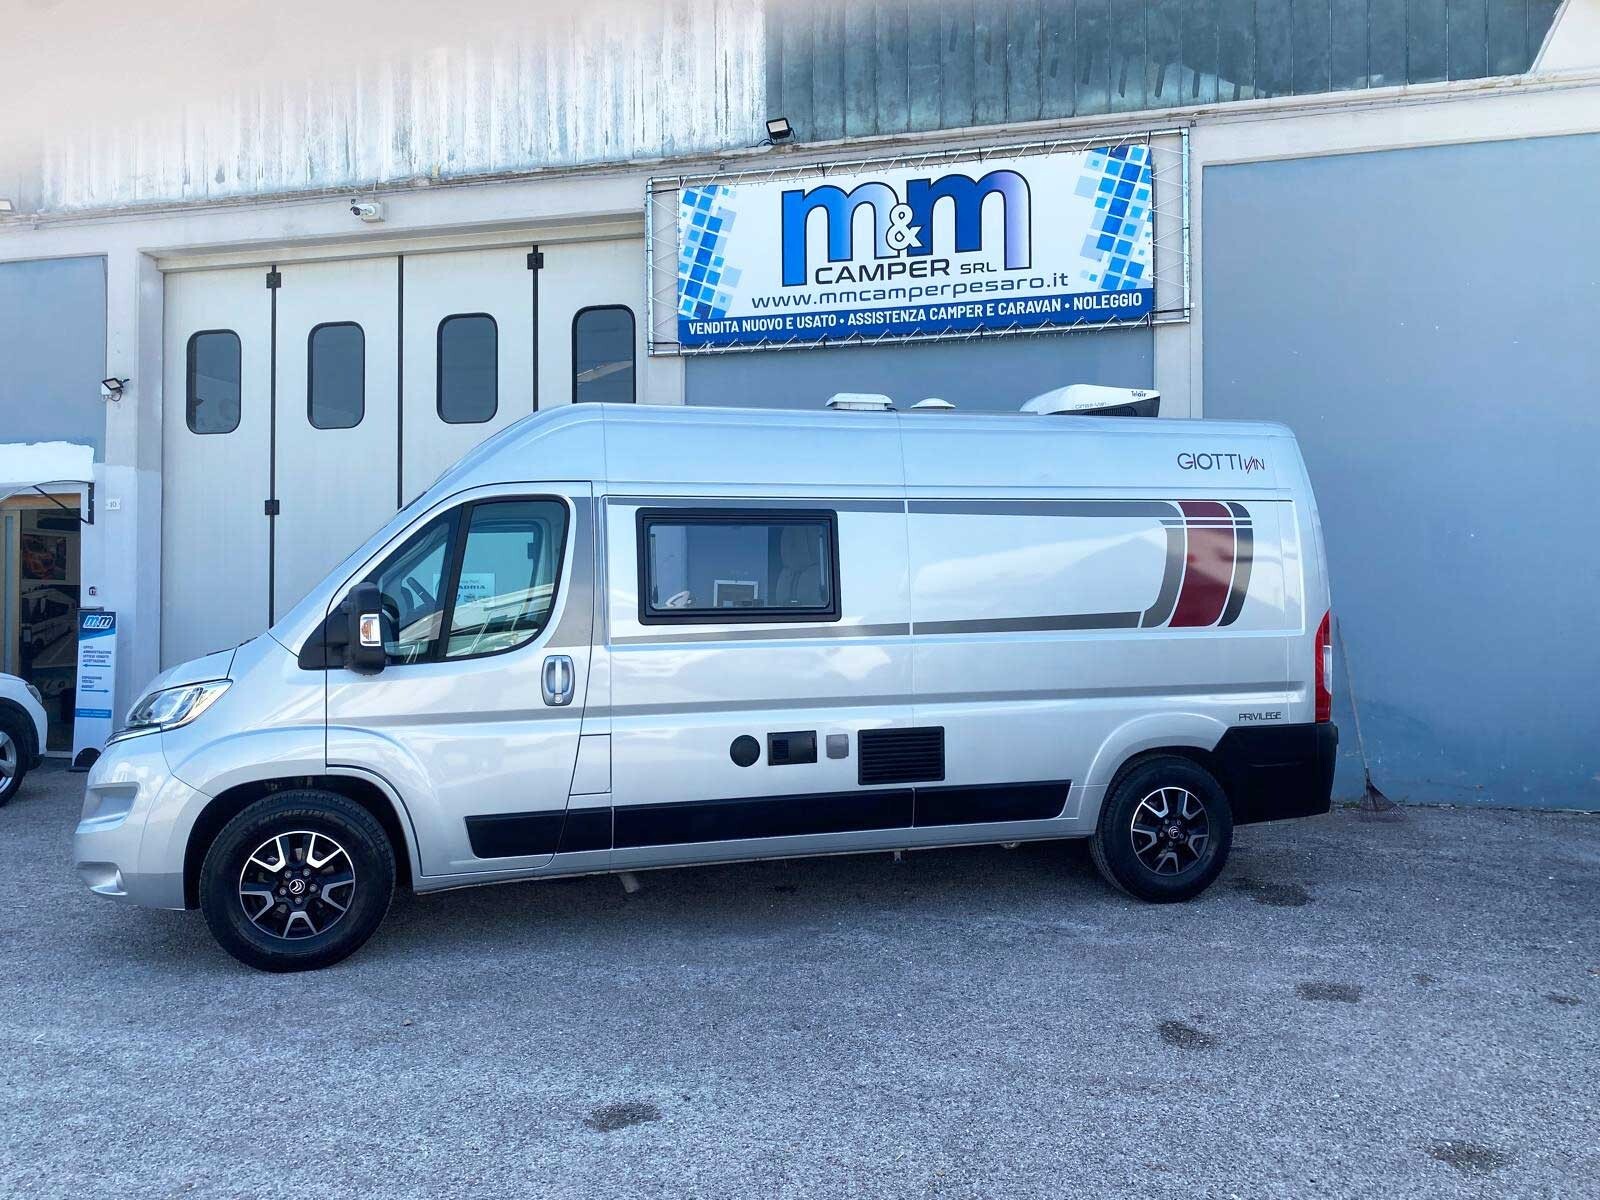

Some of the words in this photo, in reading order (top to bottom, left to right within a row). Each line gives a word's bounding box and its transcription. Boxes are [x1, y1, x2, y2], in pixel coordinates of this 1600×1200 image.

[815, 258, 950, 285] CAMPER
[960, 262, 997, 275] SRL
[751, 273, 1069, 309] www.mmcamperpesaro.it
[688, 320, 740, 335] VENDITA
[742, 318, 783, 332] NUOVO
[786, 317, 794, 330] E
[796, 314, 837, 329] USATO
[847, 307, 926, 326] ASSISTENZA
[929, 304, 983, 320] CAMPER
[986, 302, 995, 316] E
[998, 298, 1062, 315] CARAVAN
[1073, 292, 1143, 311] NOLEGGIO
[1238, 711, 1282, 721] PRIVILEGE
